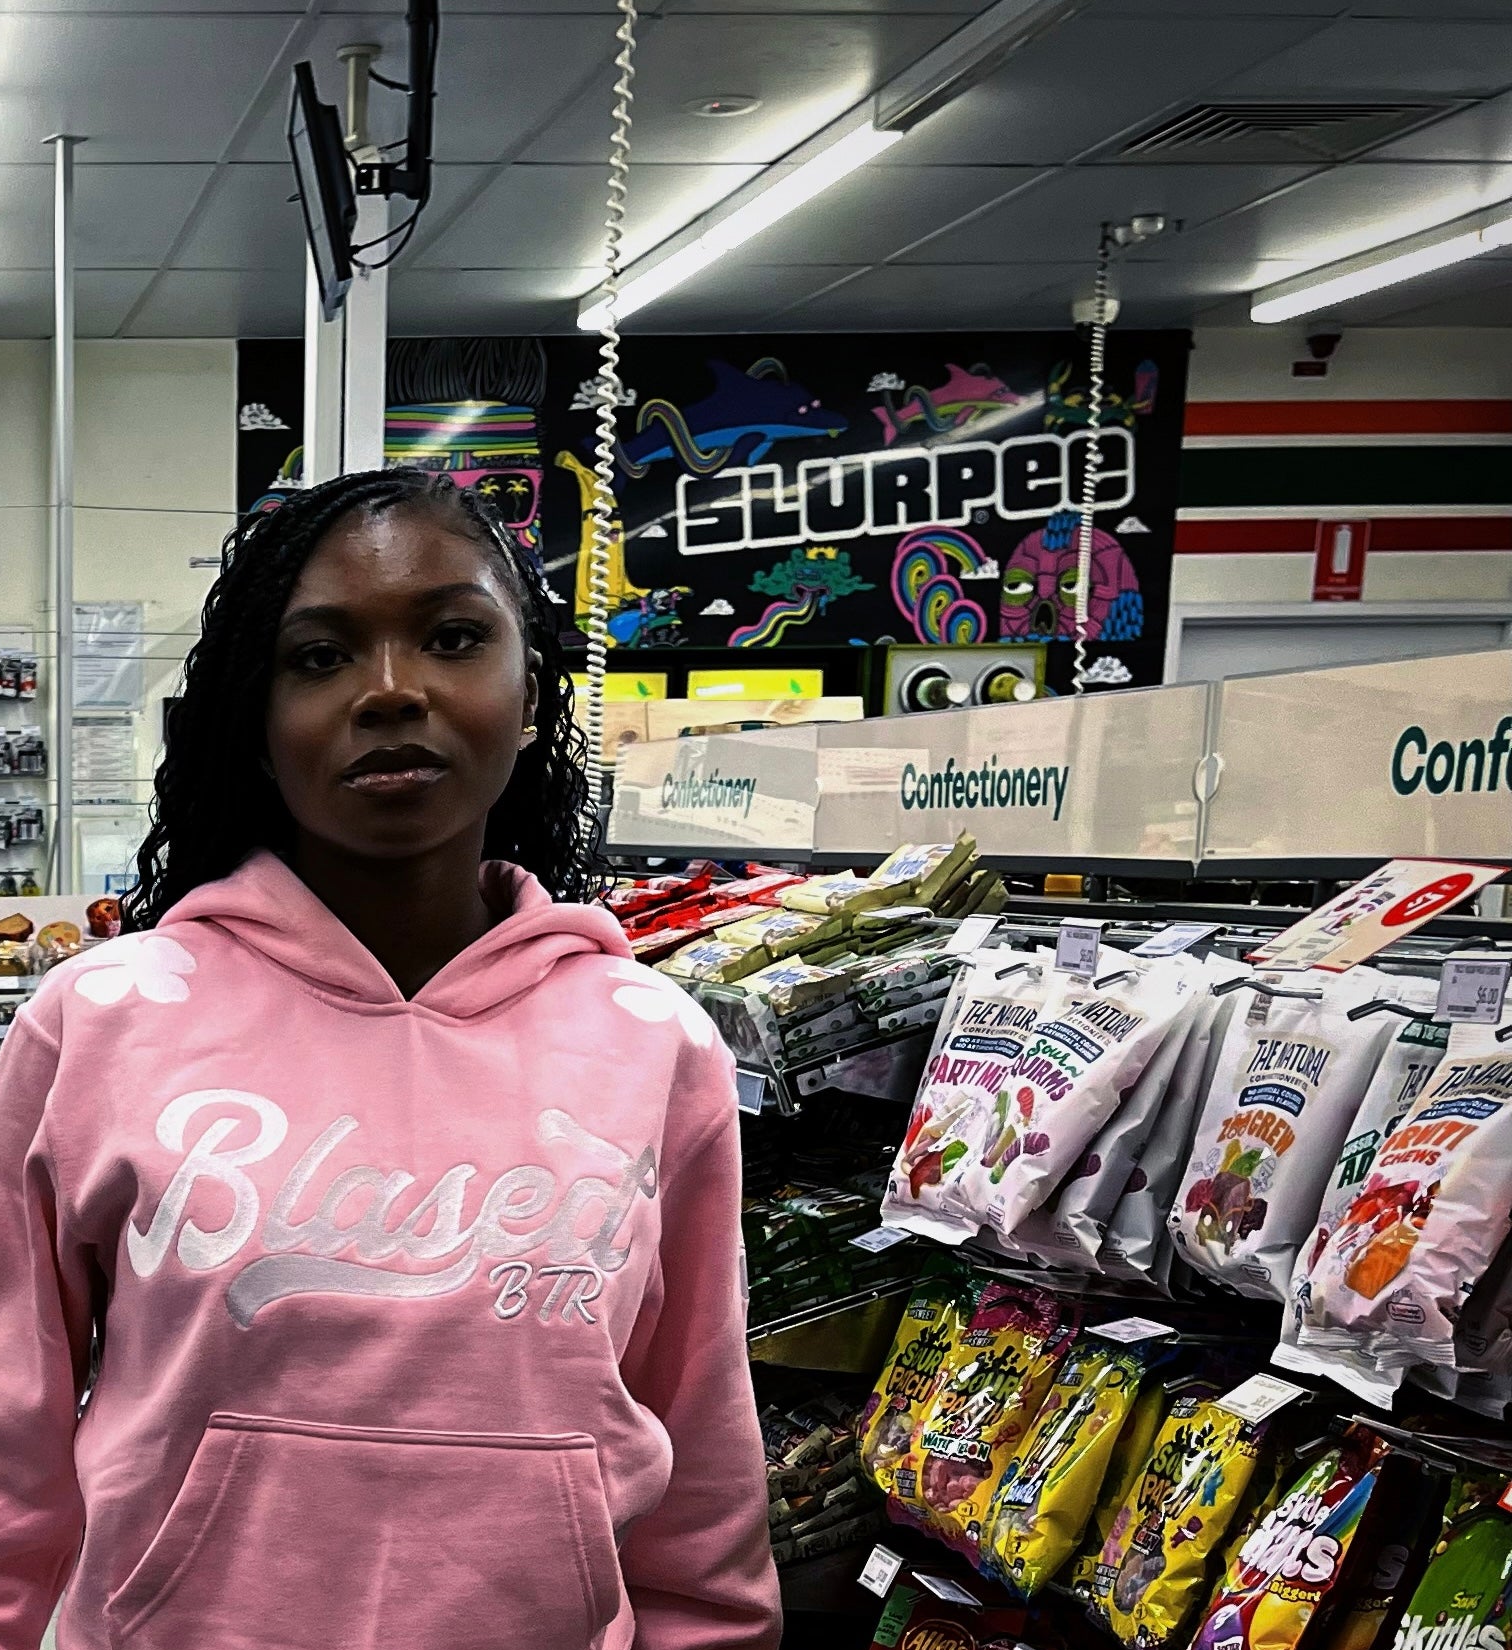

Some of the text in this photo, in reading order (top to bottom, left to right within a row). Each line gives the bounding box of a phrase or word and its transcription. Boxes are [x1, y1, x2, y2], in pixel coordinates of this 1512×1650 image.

[661, 768, 757, 819] Confectionery
[900, 754, 1070, 822] Confectionery
[961, 999, 1039, 1033] THE NATUR
[1080, 1000, 1143, 1043] NATURAL
[1246, 1038, 1331, 1087] THE NATURAL
[1378, 1148, 1442, 1168] CHEWS
[126, 1087, 659, 1300] Blased
[488, 1259, 607, 1326] BTR
[901, 1341, 945, 1377] SOUR
[886, 1365, 934, 1403] PATCH
